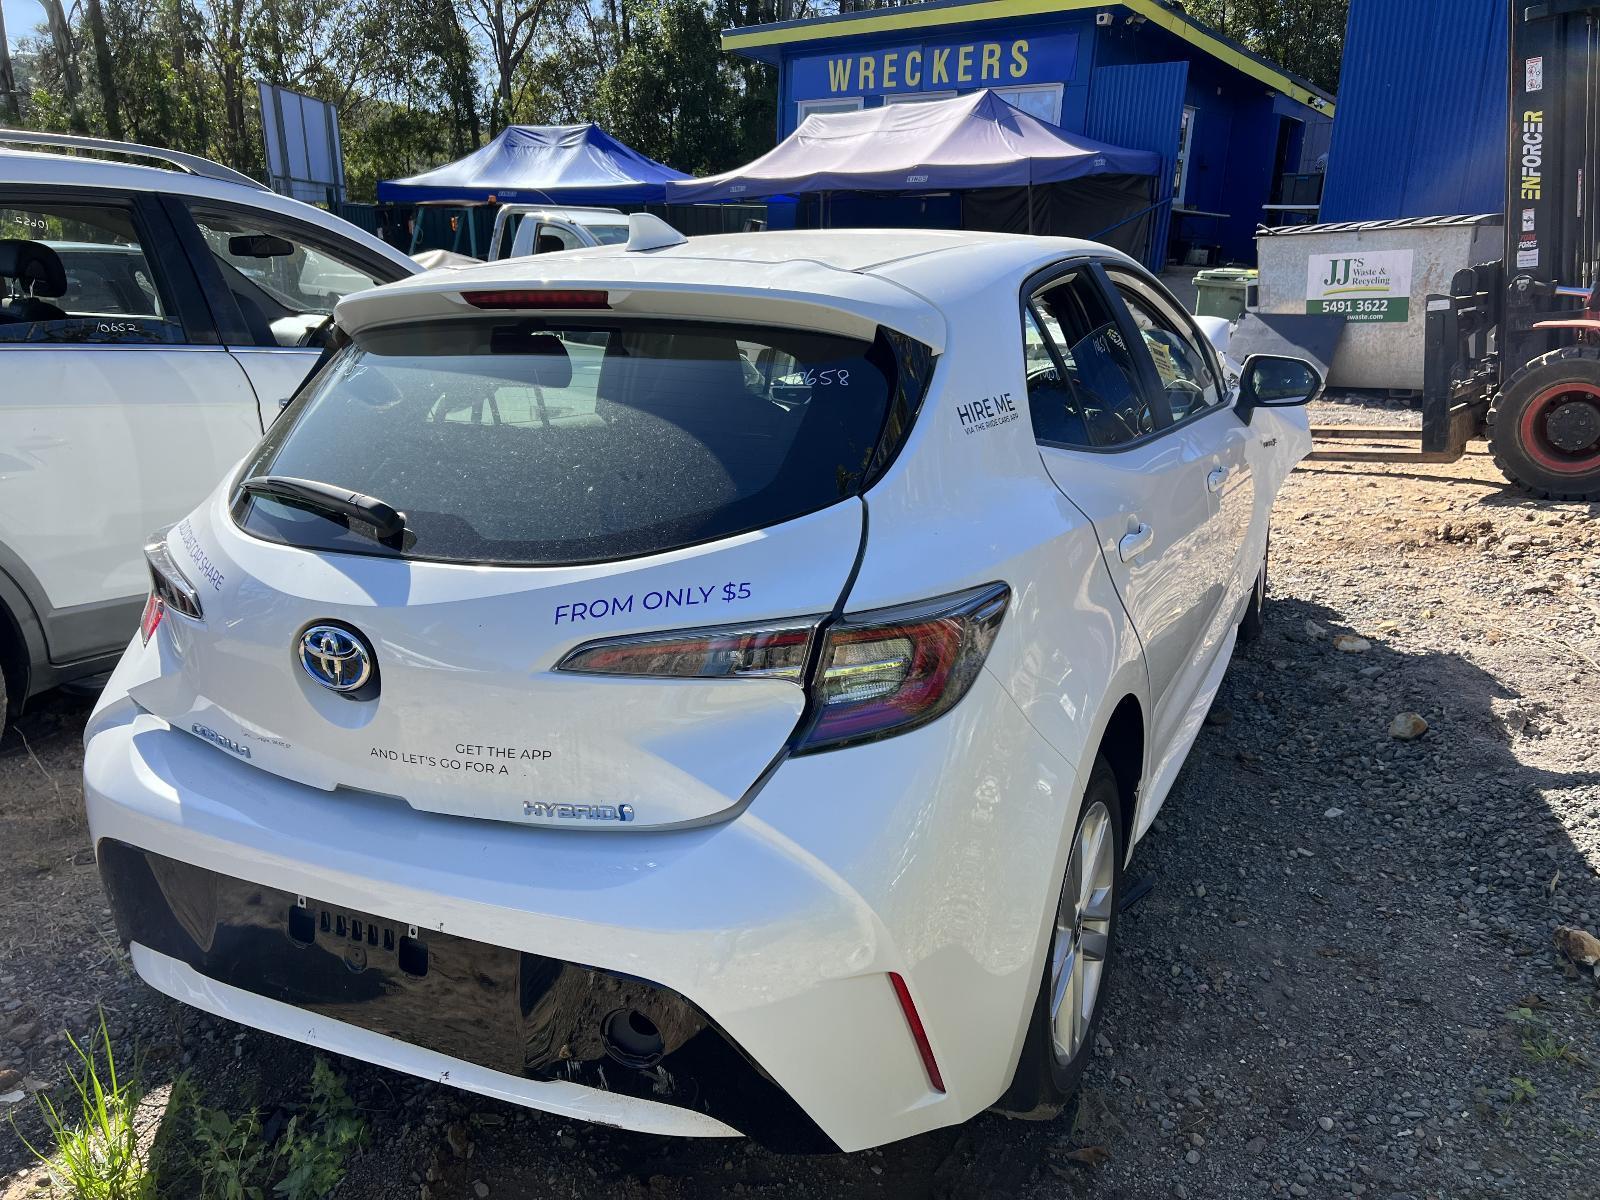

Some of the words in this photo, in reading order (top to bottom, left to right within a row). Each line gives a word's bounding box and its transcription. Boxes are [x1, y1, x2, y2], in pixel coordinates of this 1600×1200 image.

[828, 39, 1029, 92] WRECKERS
[1521, 110, 1543, 200] ENFORCER
[1352, 276, 1391, 286] Recycling
[1353, 268, 1377, 276] Waste
[1378, 267, 1386, 275] &
[1322, 301, 1353, 313] 5491
[1356, 300, 1388, 312] 3622
[96, 321, 140, 333] 10652
[956, 398, 995, 425] HIRE
[993, 393, 1016, 415] ME
[964, 427, 975, 435] VIA
[974, 422, 986, 432] THE
[199, 557, 225, 591] SHARE
[554, 594, 634, 625] FROM
[642, 585, 716, 611] ONLY
[721, 581, 752, 603] $5
[370, 747, 398, 761] AND
[401, 753, 437, 767] LET'S
[439, 758, 461, 770] GO
[465, 761, 495, 774] FOR
[498, 765, 509, 775] A
[455, 743, 484, 756] GET
[487, 746, 516, 759] THE
[520, 749, 553, 761] APP
[523, 800, 618, 821] HYBRID
